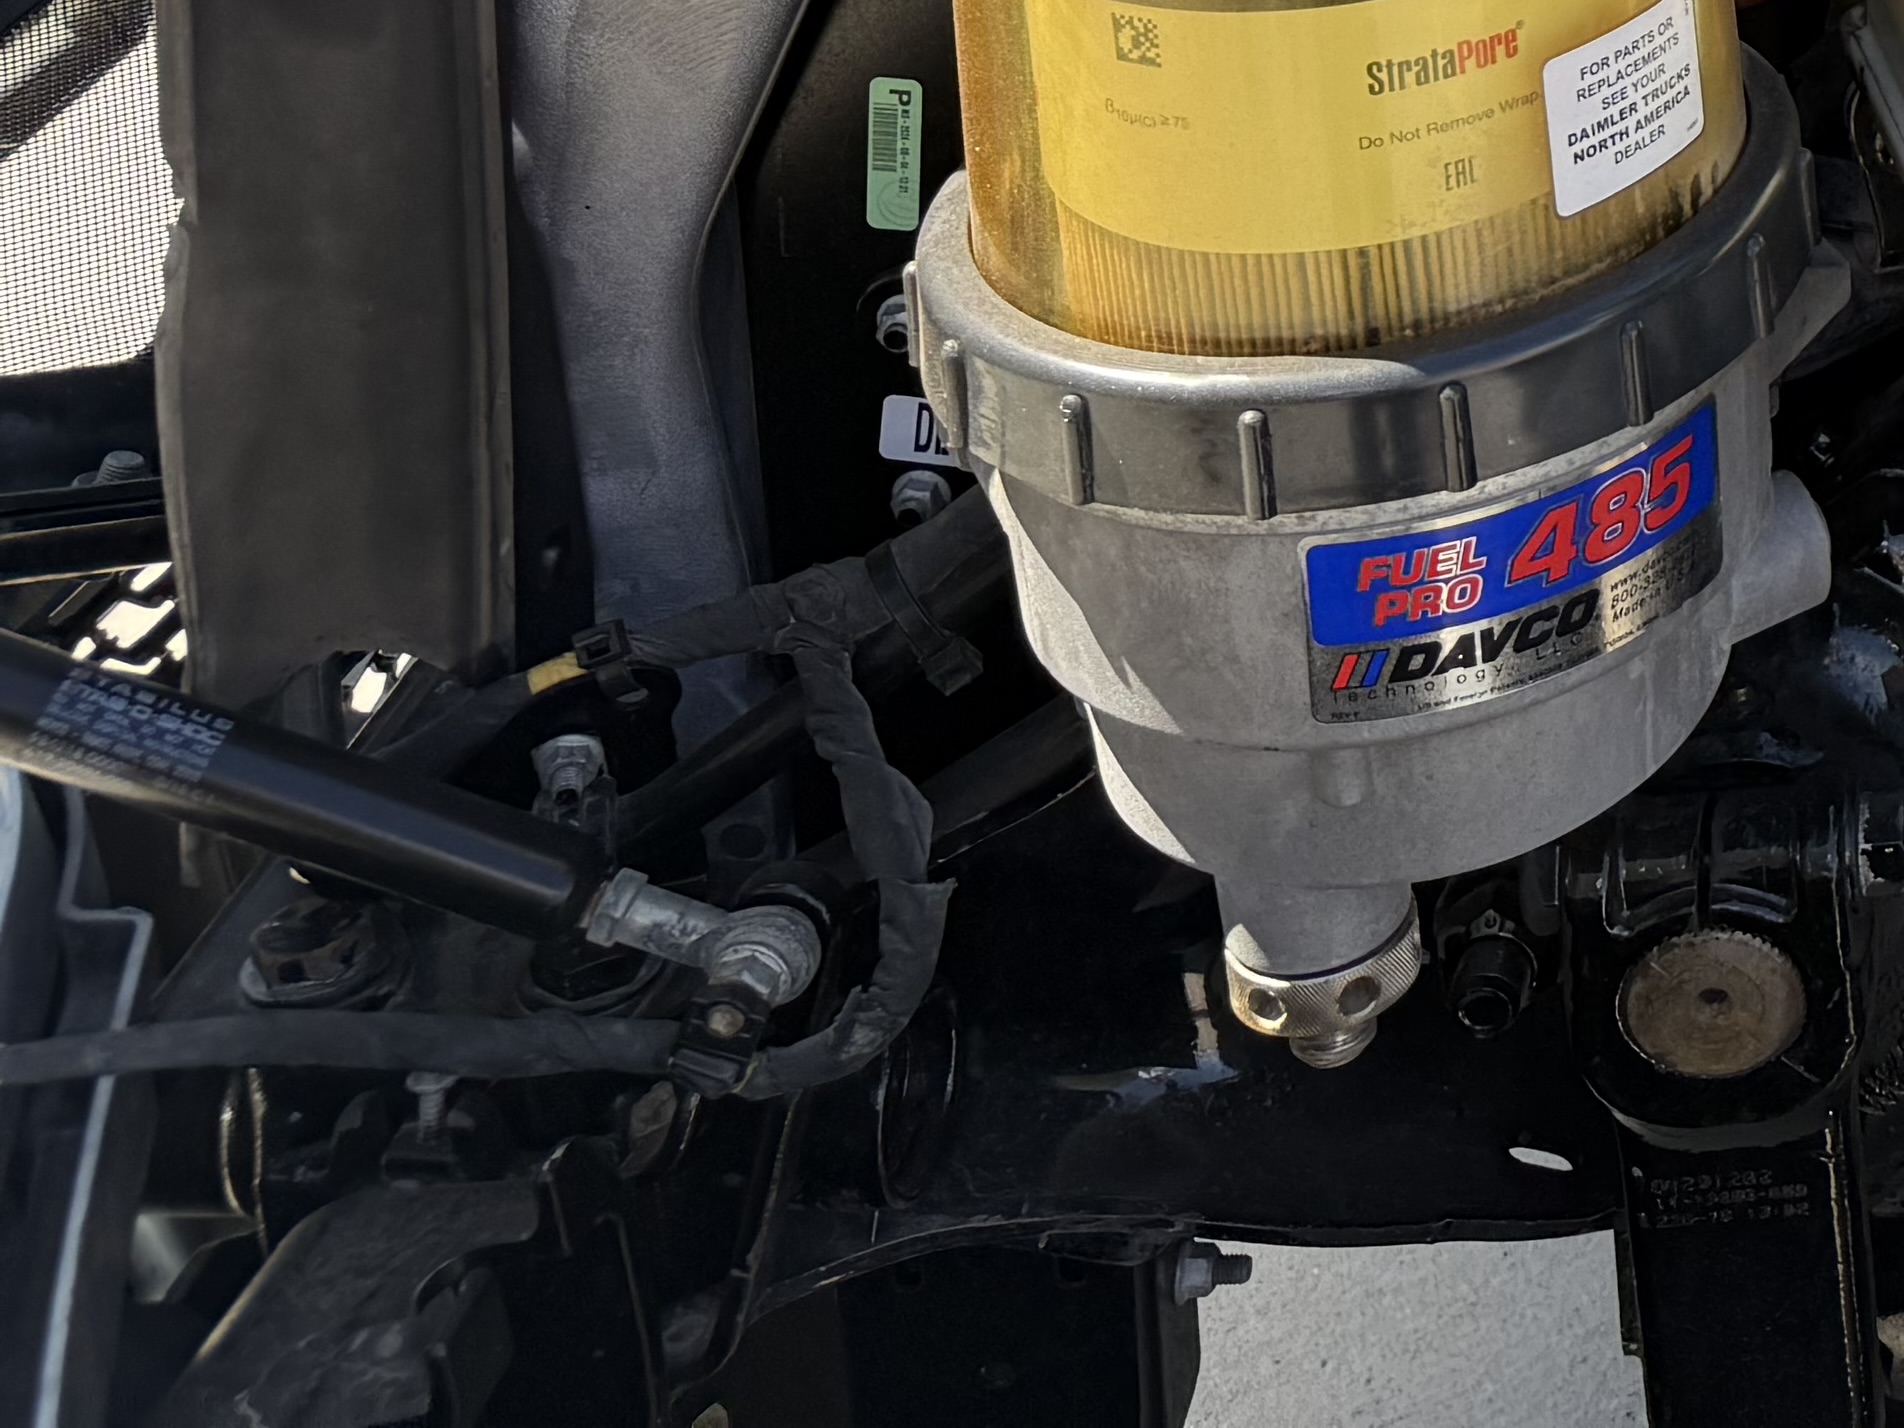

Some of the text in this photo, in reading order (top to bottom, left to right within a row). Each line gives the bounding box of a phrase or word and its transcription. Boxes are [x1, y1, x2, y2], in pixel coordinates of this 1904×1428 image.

[1577, 32, 1680, 102] REPLACEMENTS
[1580, 16, 1674, 81] FOR PARTS OR
[889, 88, 912, 107] P
[1567, 63, 1691, 147] DAIMLER TRUCKS
[1602, 63, 1666, 111] SEE YOUR
[1359, 91, 1540, 150] Do Not Remove Wrap
[1573, 85, 1691, 165] NORTH AMERICA
[1614, 124, 1665, 165] DEALER
[1356, 535, 1487, 592] FUEL
[1504, 434, 1695, 588] 485
[1373, 573, 1485, 628] PRO
[1611, 598, 1644, 623] Made
[1388, 589, 1600, 683] DAVCO
[1331, 663, 1504, 704] Technology
